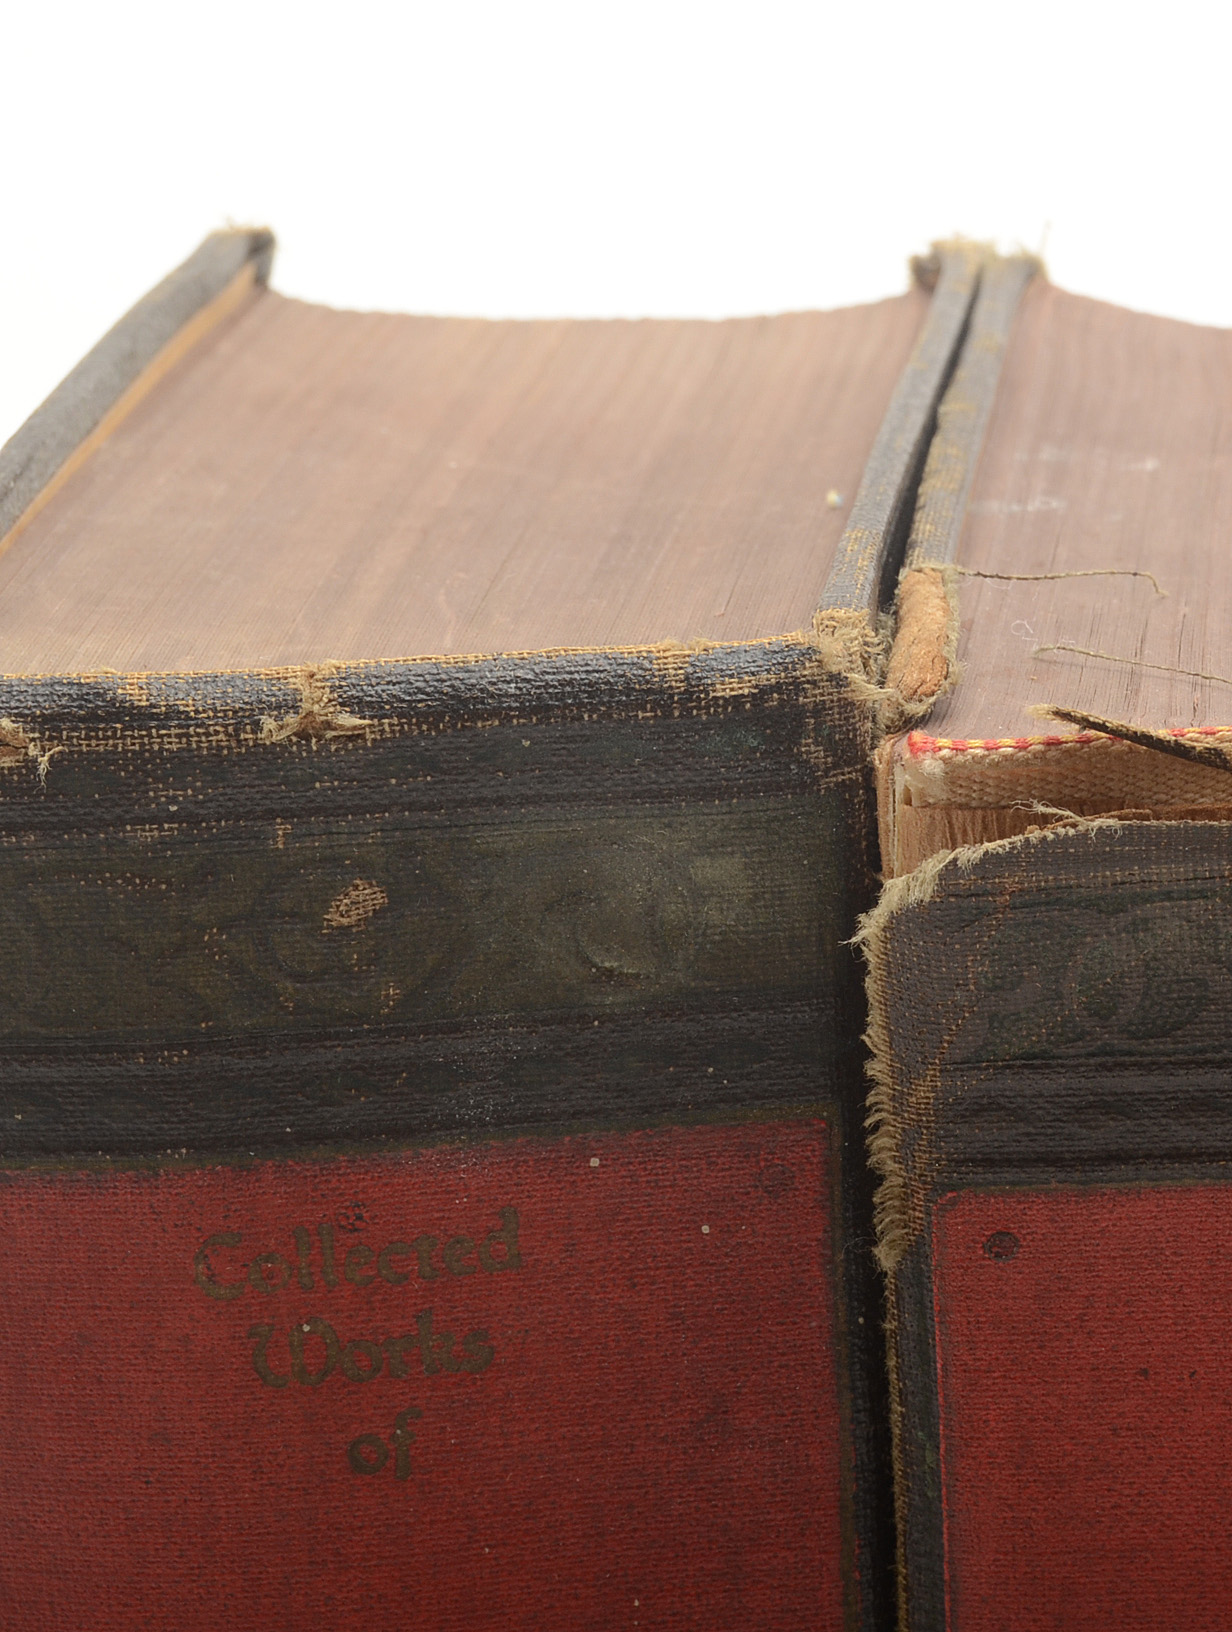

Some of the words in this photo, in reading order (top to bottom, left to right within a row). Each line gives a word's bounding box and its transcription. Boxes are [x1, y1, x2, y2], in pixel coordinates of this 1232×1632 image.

[194, 1205, 522, 1300] Collected
[247, 1308, 496, 1388] Works
[347, 1407, 423, 1480] of
